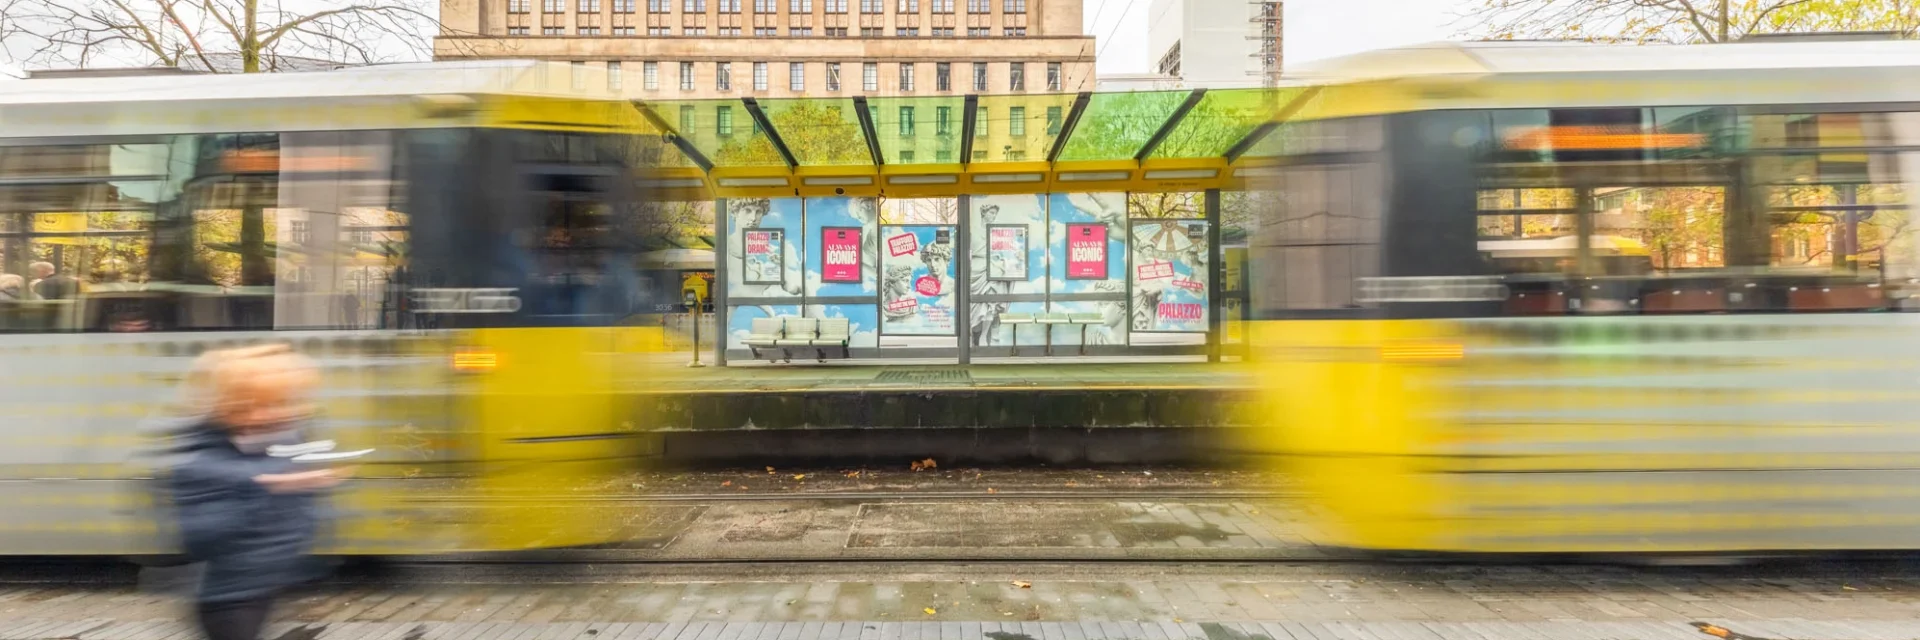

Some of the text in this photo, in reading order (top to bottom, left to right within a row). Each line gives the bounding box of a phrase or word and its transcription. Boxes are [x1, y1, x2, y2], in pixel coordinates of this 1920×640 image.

[747, 232, 769, 240] PALAZZO
[827, 250, 857, 265] ICONIC
[1072, 247, 1103, 262] ICONIC
[1158, 303, 1202, 319] PALAZZO
